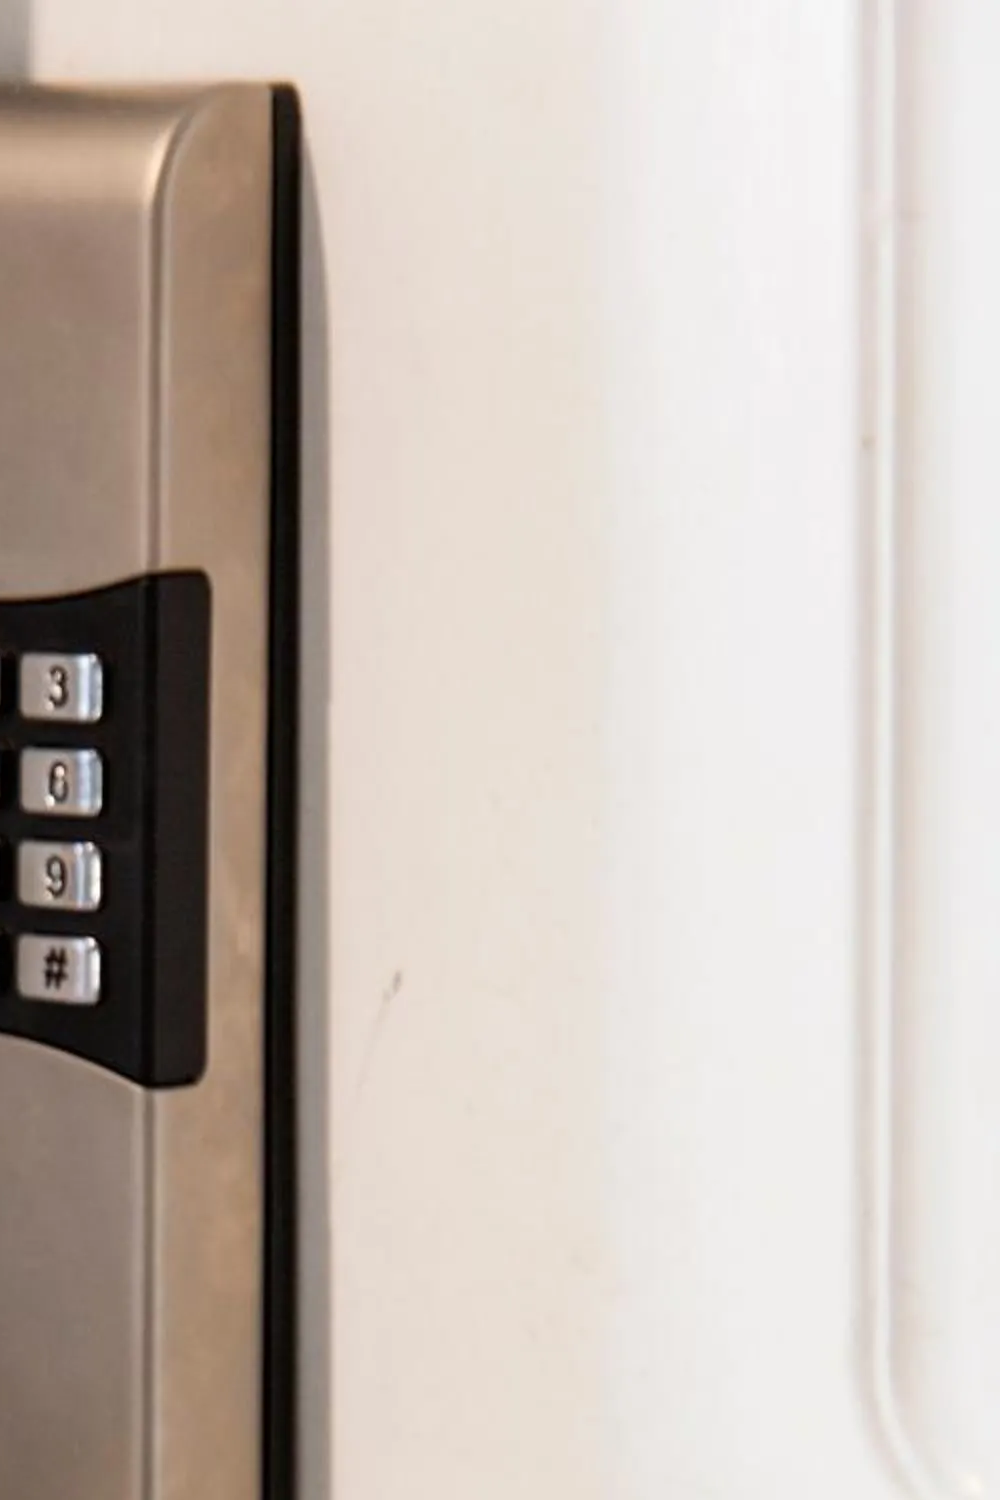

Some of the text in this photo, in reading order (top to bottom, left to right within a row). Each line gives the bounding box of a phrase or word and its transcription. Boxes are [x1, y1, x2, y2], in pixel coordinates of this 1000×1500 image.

[49, 666, 69, 707] 3
[49, 762, 69, 802] 6
[46, 855, 65, 897] 9
[44, 948, 68, 989] #
